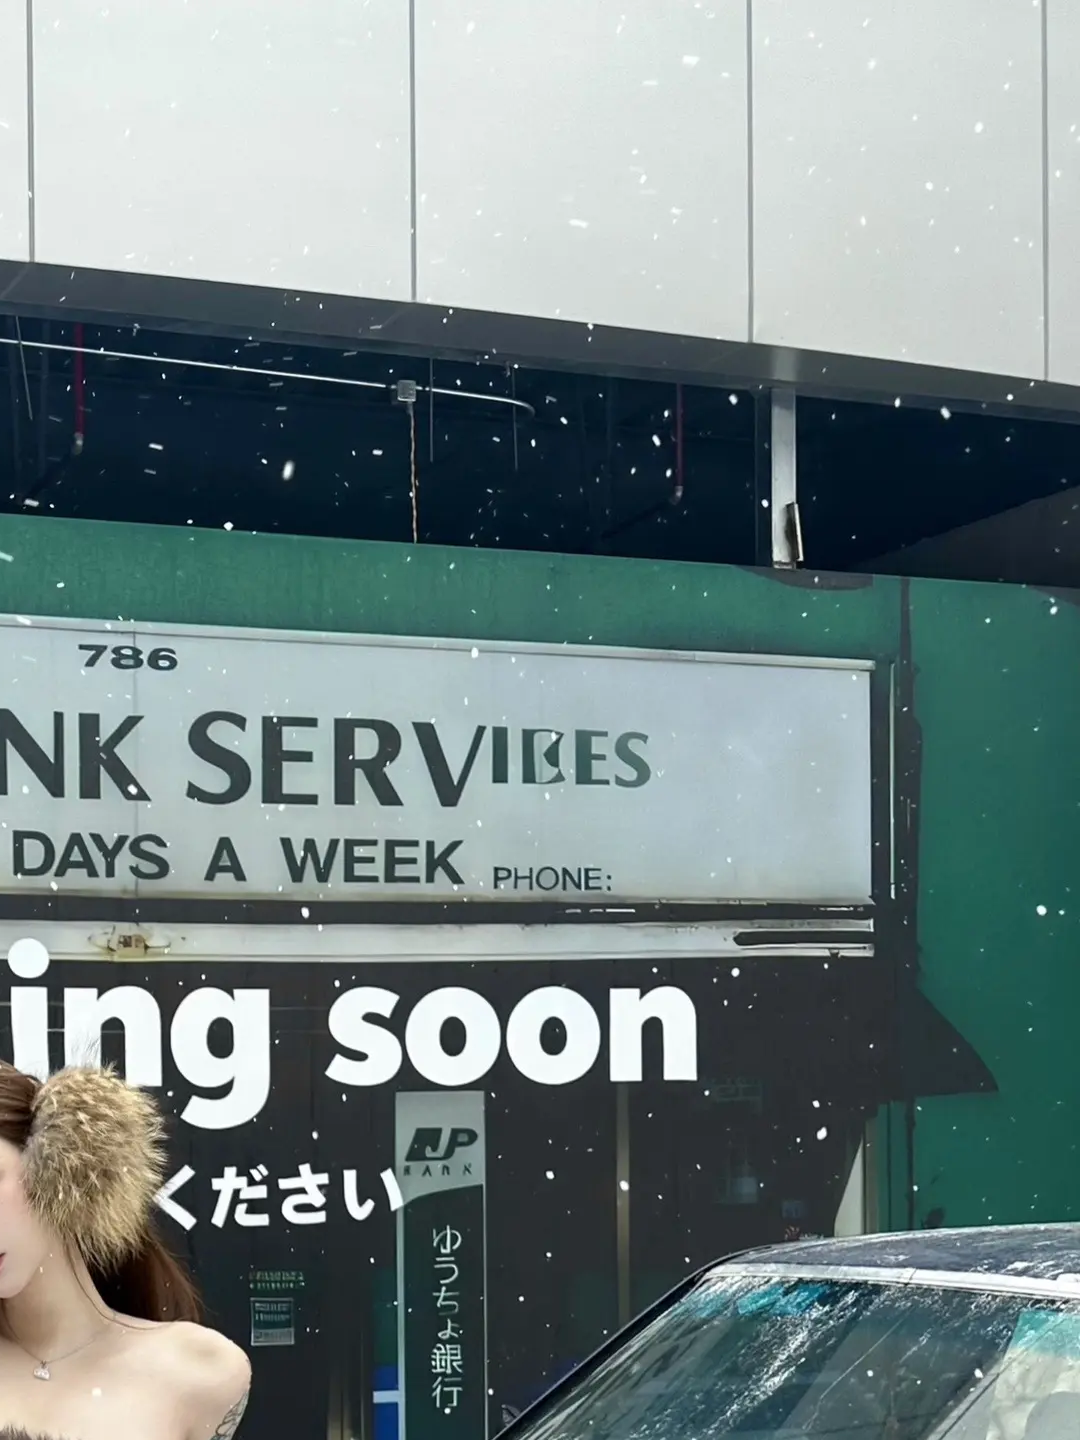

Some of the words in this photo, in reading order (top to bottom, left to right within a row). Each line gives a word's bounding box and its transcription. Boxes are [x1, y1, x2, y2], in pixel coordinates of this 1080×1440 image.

[79, 644, 177, 670] 786
[13, 830, 169, 880] DAYS
[204, 837, 246, 881] A
[280, 838, 465, 884] WEEK
[494, 866, 612, 892] PHONE:
[325, 985, 697, 1086] soon
[431, 1224, 463, 1408] ゆうちょ銀行
